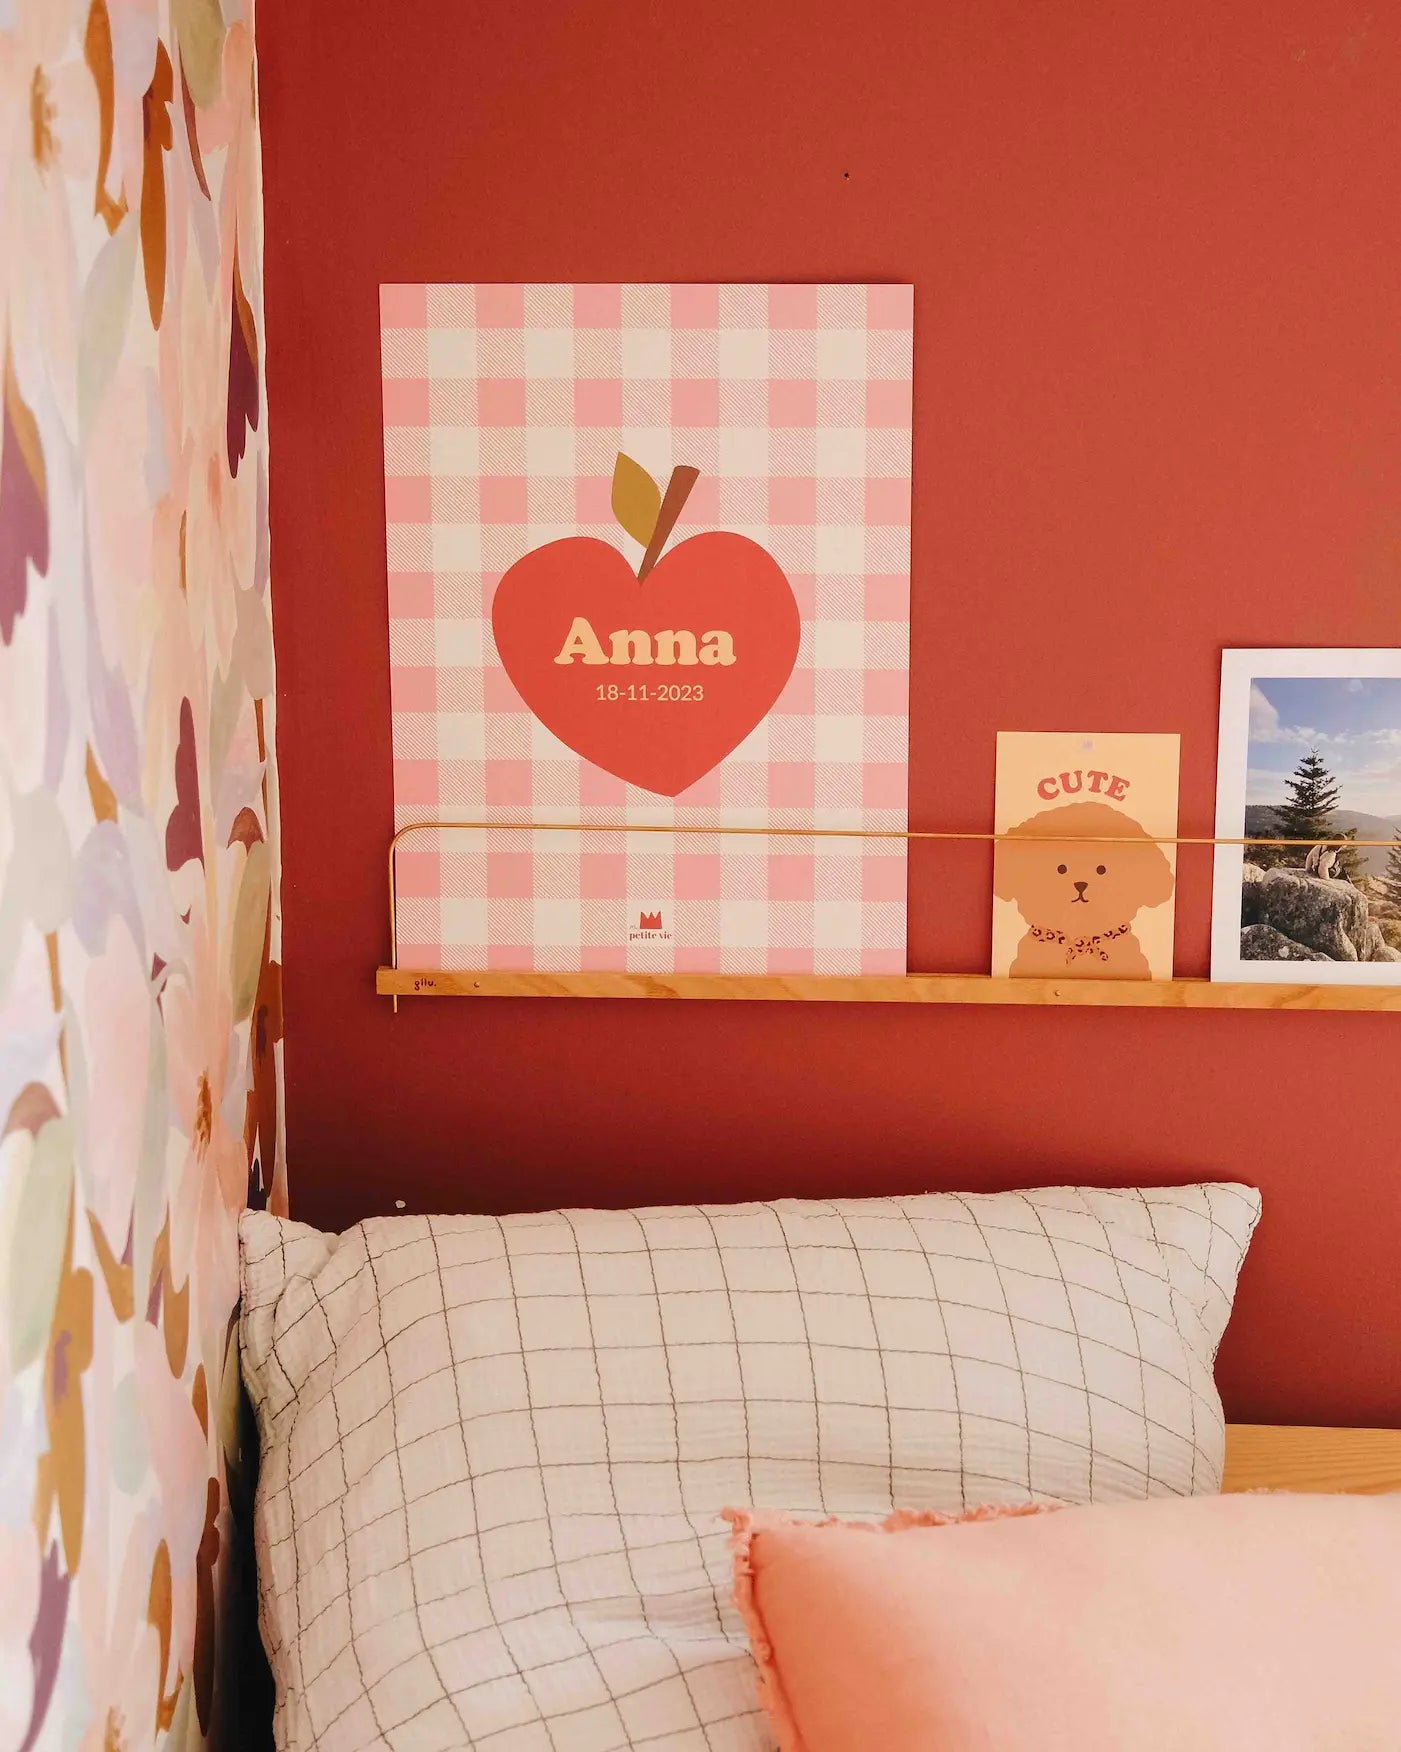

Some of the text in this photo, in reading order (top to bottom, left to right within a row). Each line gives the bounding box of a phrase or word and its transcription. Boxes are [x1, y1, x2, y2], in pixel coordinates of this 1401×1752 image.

[554, 617, 736, 666] Anna
[596, 684, 704, 701] 18-11-2023
[1037, 770, 1130, 801] CUTE
[629, 931, 672, 941] petite vie
